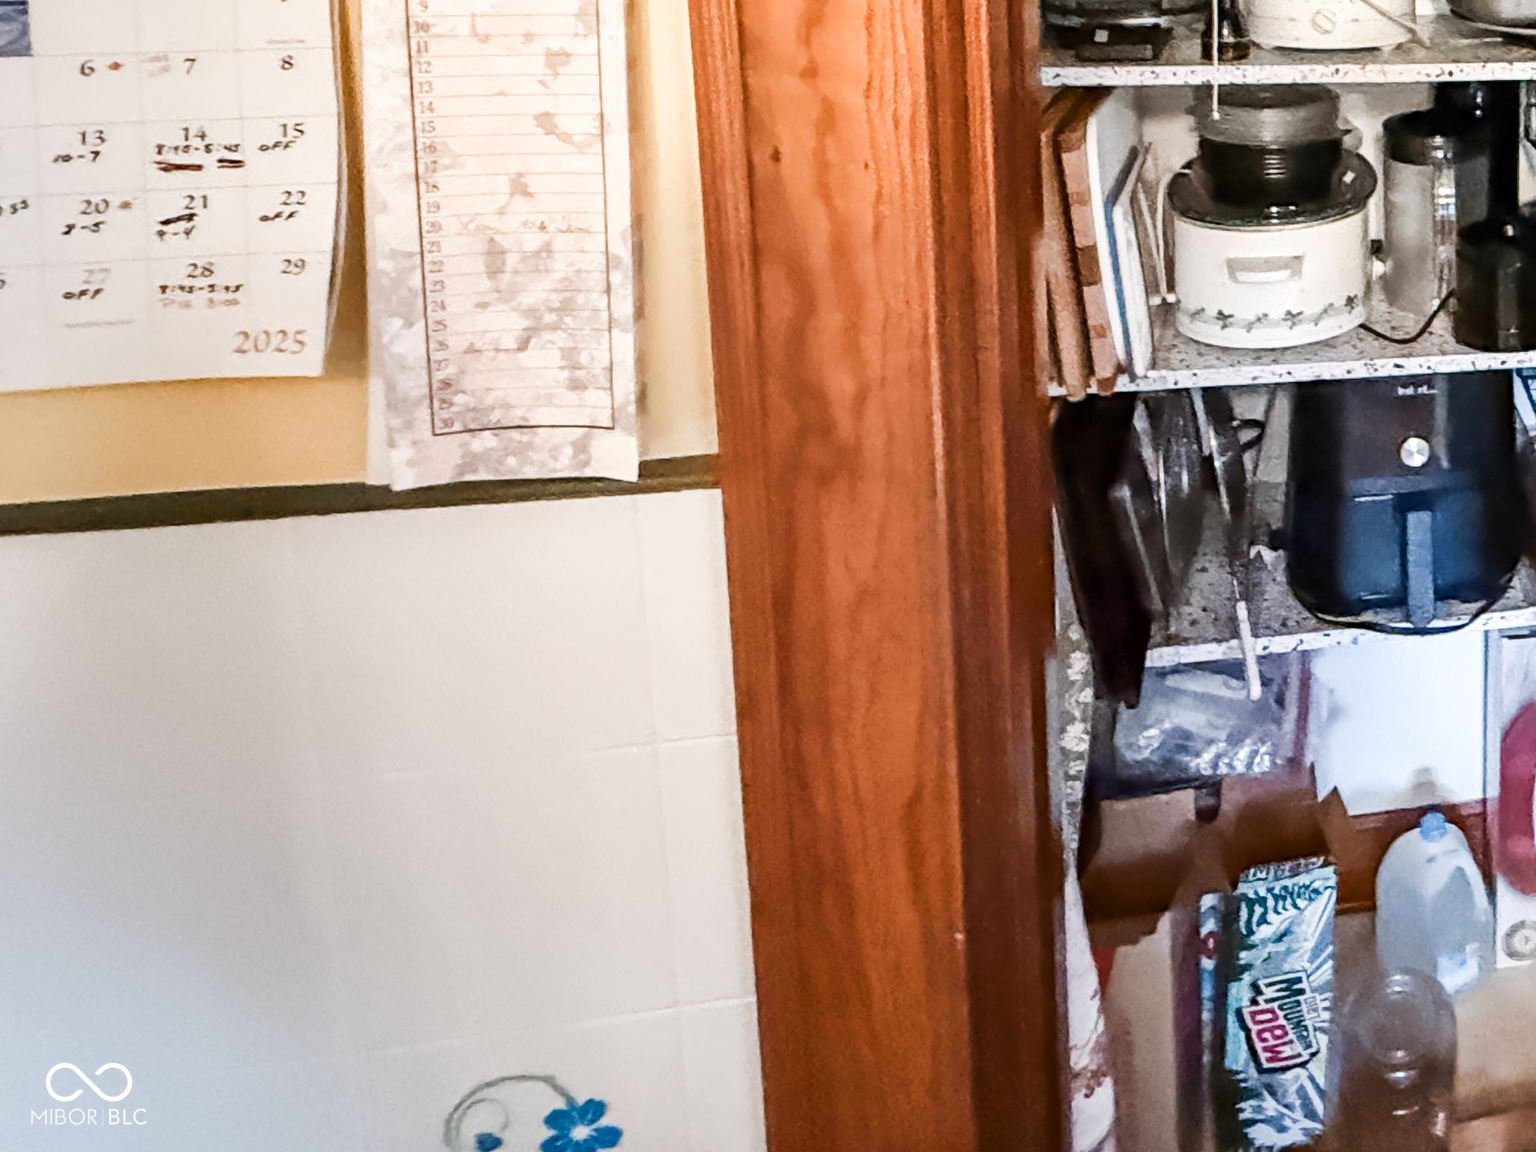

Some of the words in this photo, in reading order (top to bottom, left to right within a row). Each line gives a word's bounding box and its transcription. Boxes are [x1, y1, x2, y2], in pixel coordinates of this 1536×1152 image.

[80, 58, 95, 77] 6
[183, 57, 197, 75] 7
[280, 54, 294, 71] 8
[78, 129, 107, 147] 13
[181, 125, 208, 142] 14
[279, 122, 305, 139] 15
[80, 198, 109, 215] 20
[184, 194, 208, 210] 21
[280, 190, 306, 206] 22
[186, 261, 215, 279] 28
[280, 258, 306, 276] 29
[232, 329, 308, 355] 2025
